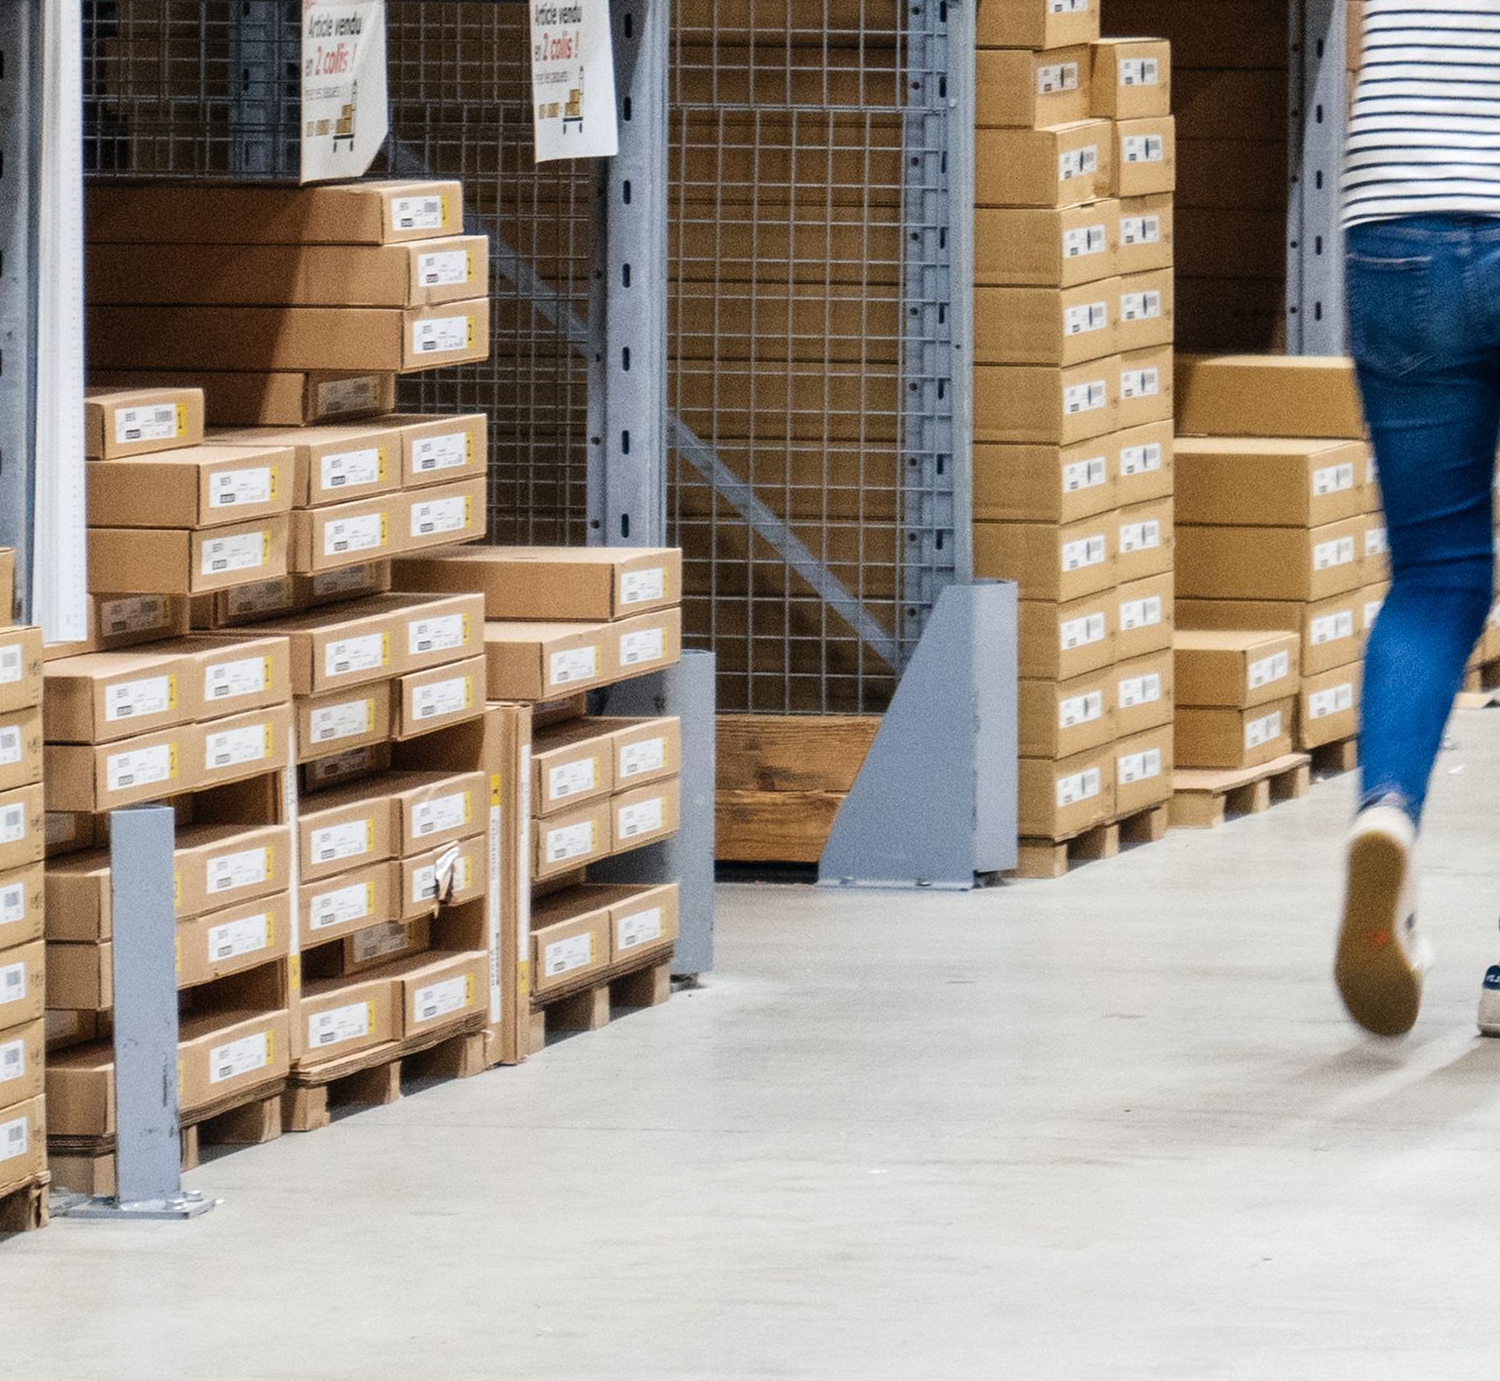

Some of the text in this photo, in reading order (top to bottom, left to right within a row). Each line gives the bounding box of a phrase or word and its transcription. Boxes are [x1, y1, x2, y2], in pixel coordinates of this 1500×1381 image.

[308, 11, 363, 39] Article vendu
[535, 1, 582, 27] Article vendu
[314, 46, 323, 76] 2
[323, 42, 350, 76] colis
[543, 32, 549, 62] 2
[551, 30, 573, 60] colis
